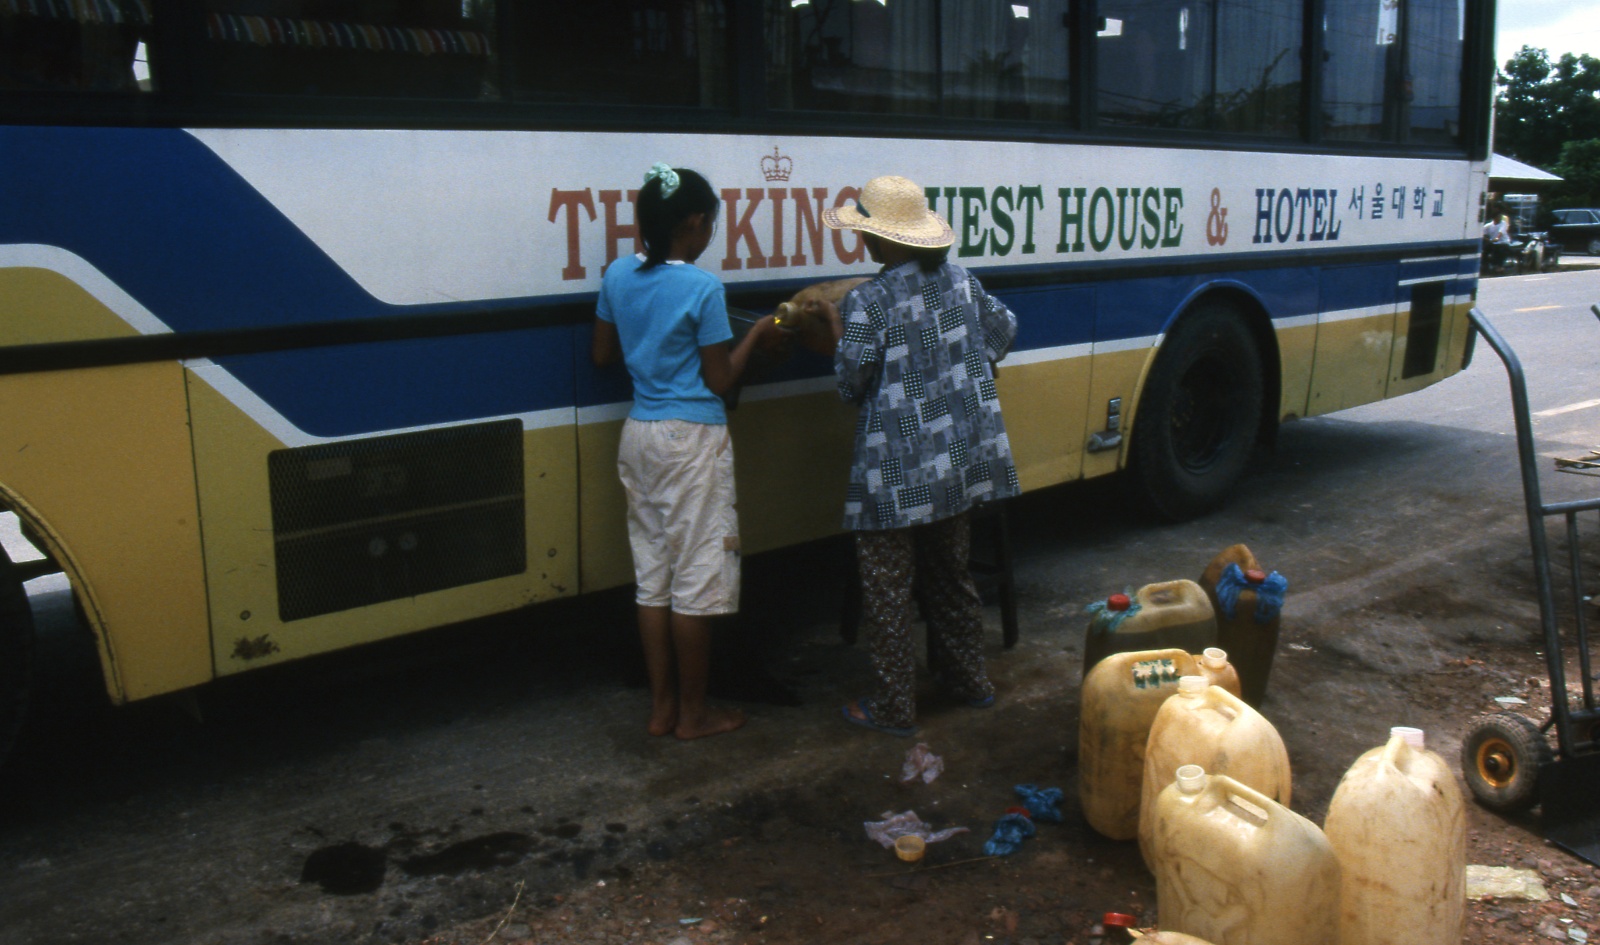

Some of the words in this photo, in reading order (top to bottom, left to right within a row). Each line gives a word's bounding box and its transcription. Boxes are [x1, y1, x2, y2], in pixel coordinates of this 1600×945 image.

[720, 185, 866, 270] KING
[922, 184, 1044, 258] UEST
[1056, 186, 1184, 253] HOUSE
[1206, 187, 1228, 246] &
[1252, 187, 1342, 243] HOTEL
